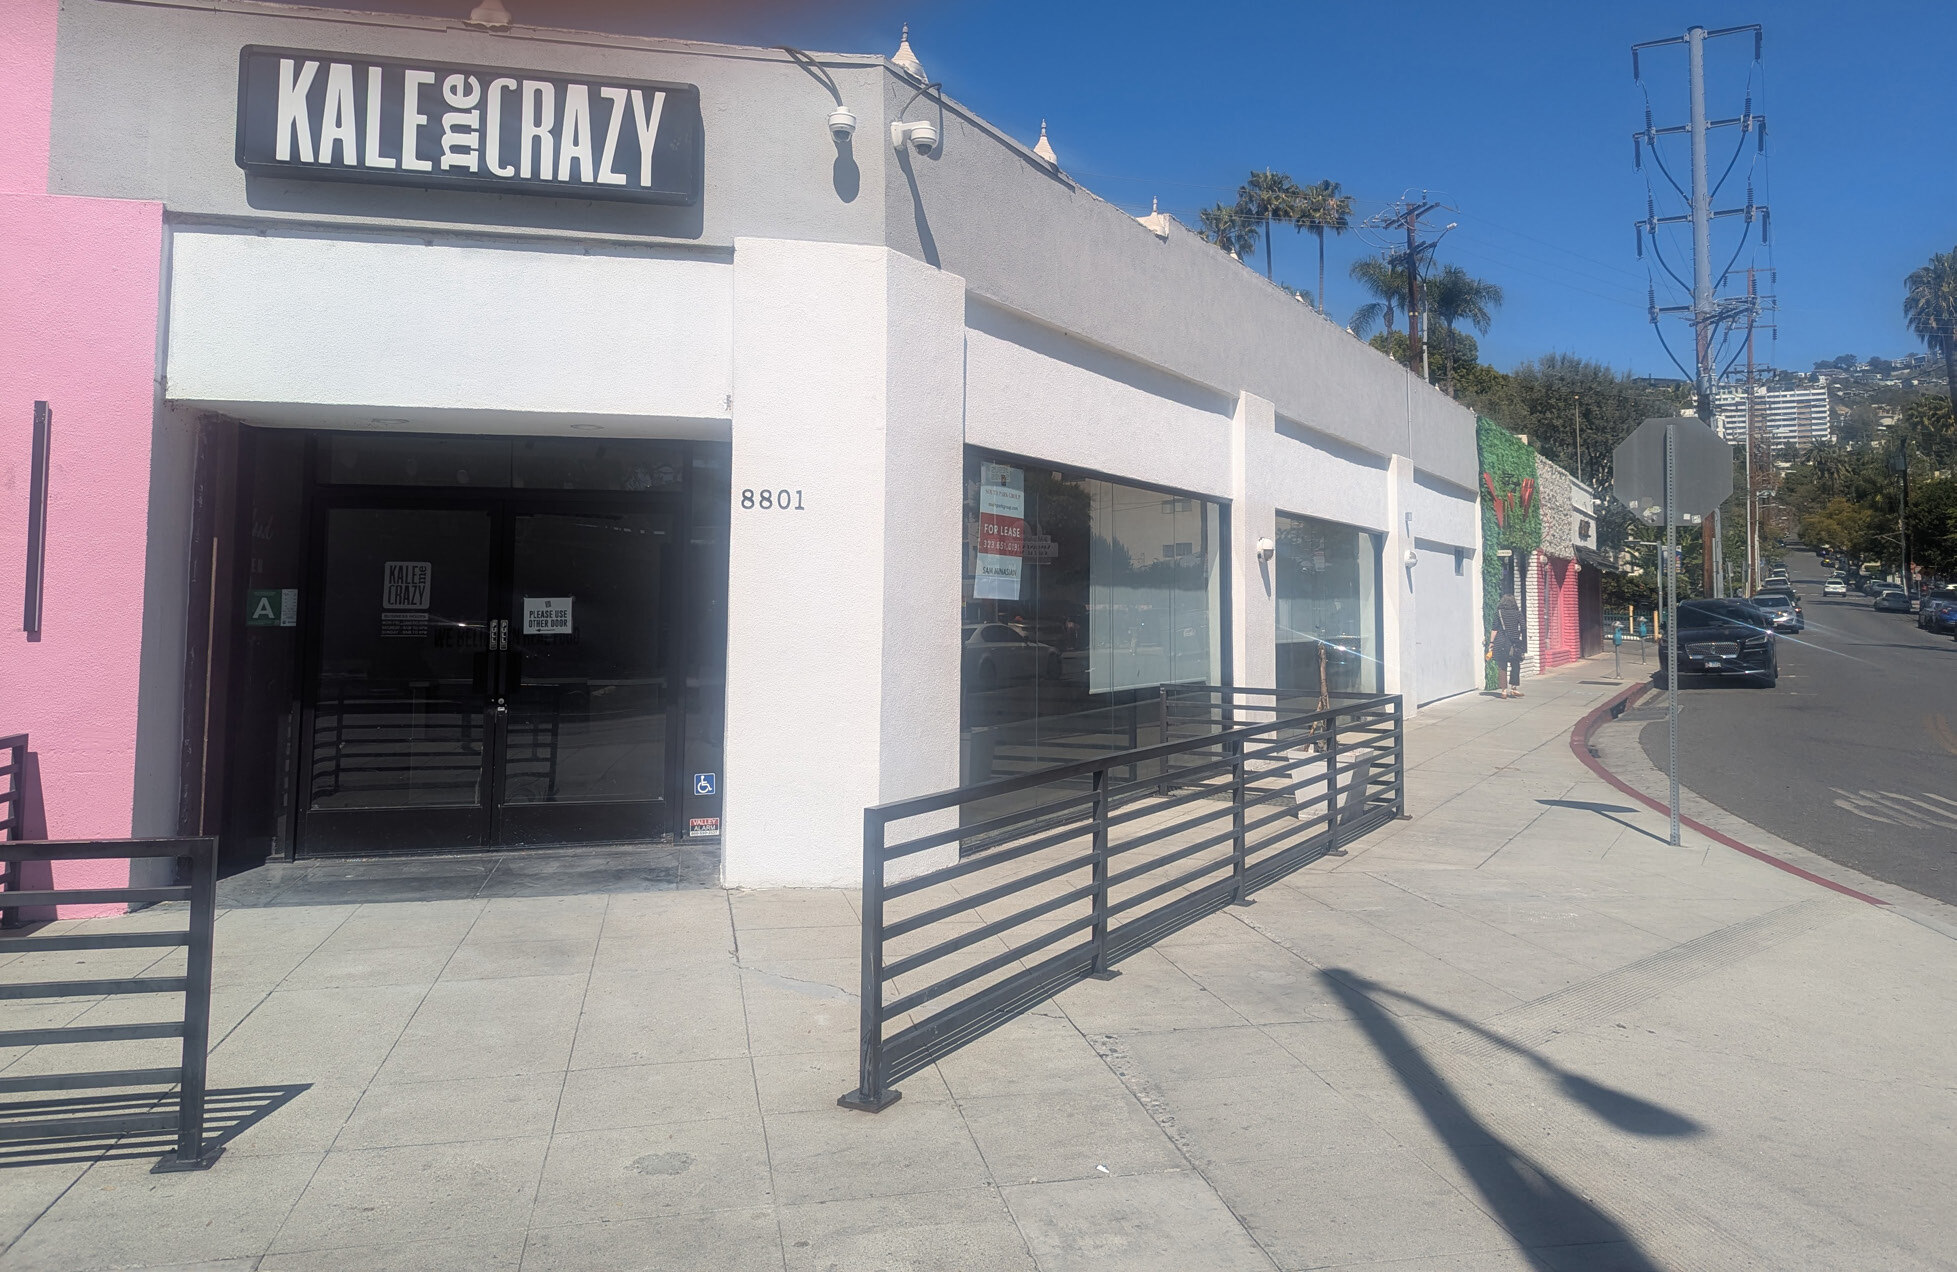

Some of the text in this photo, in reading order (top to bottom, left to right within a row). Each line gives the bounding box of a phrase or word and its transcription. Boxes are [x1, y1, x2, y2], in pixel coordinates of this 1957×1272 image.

[275, 58, 667, 187] KALE me CRAZY
[741, 488, 805, 511] 8801
[984, 523, 1020, 538] FOR LEASE
[389, 565, 427, 585] KALE me
[388, 585, 426, 605] CRAZY
[252, 597, 275, 619] A
[529, 609, 567, 619] PLEASE USE
[528, 619, 568, 628] OTHER DOOR
